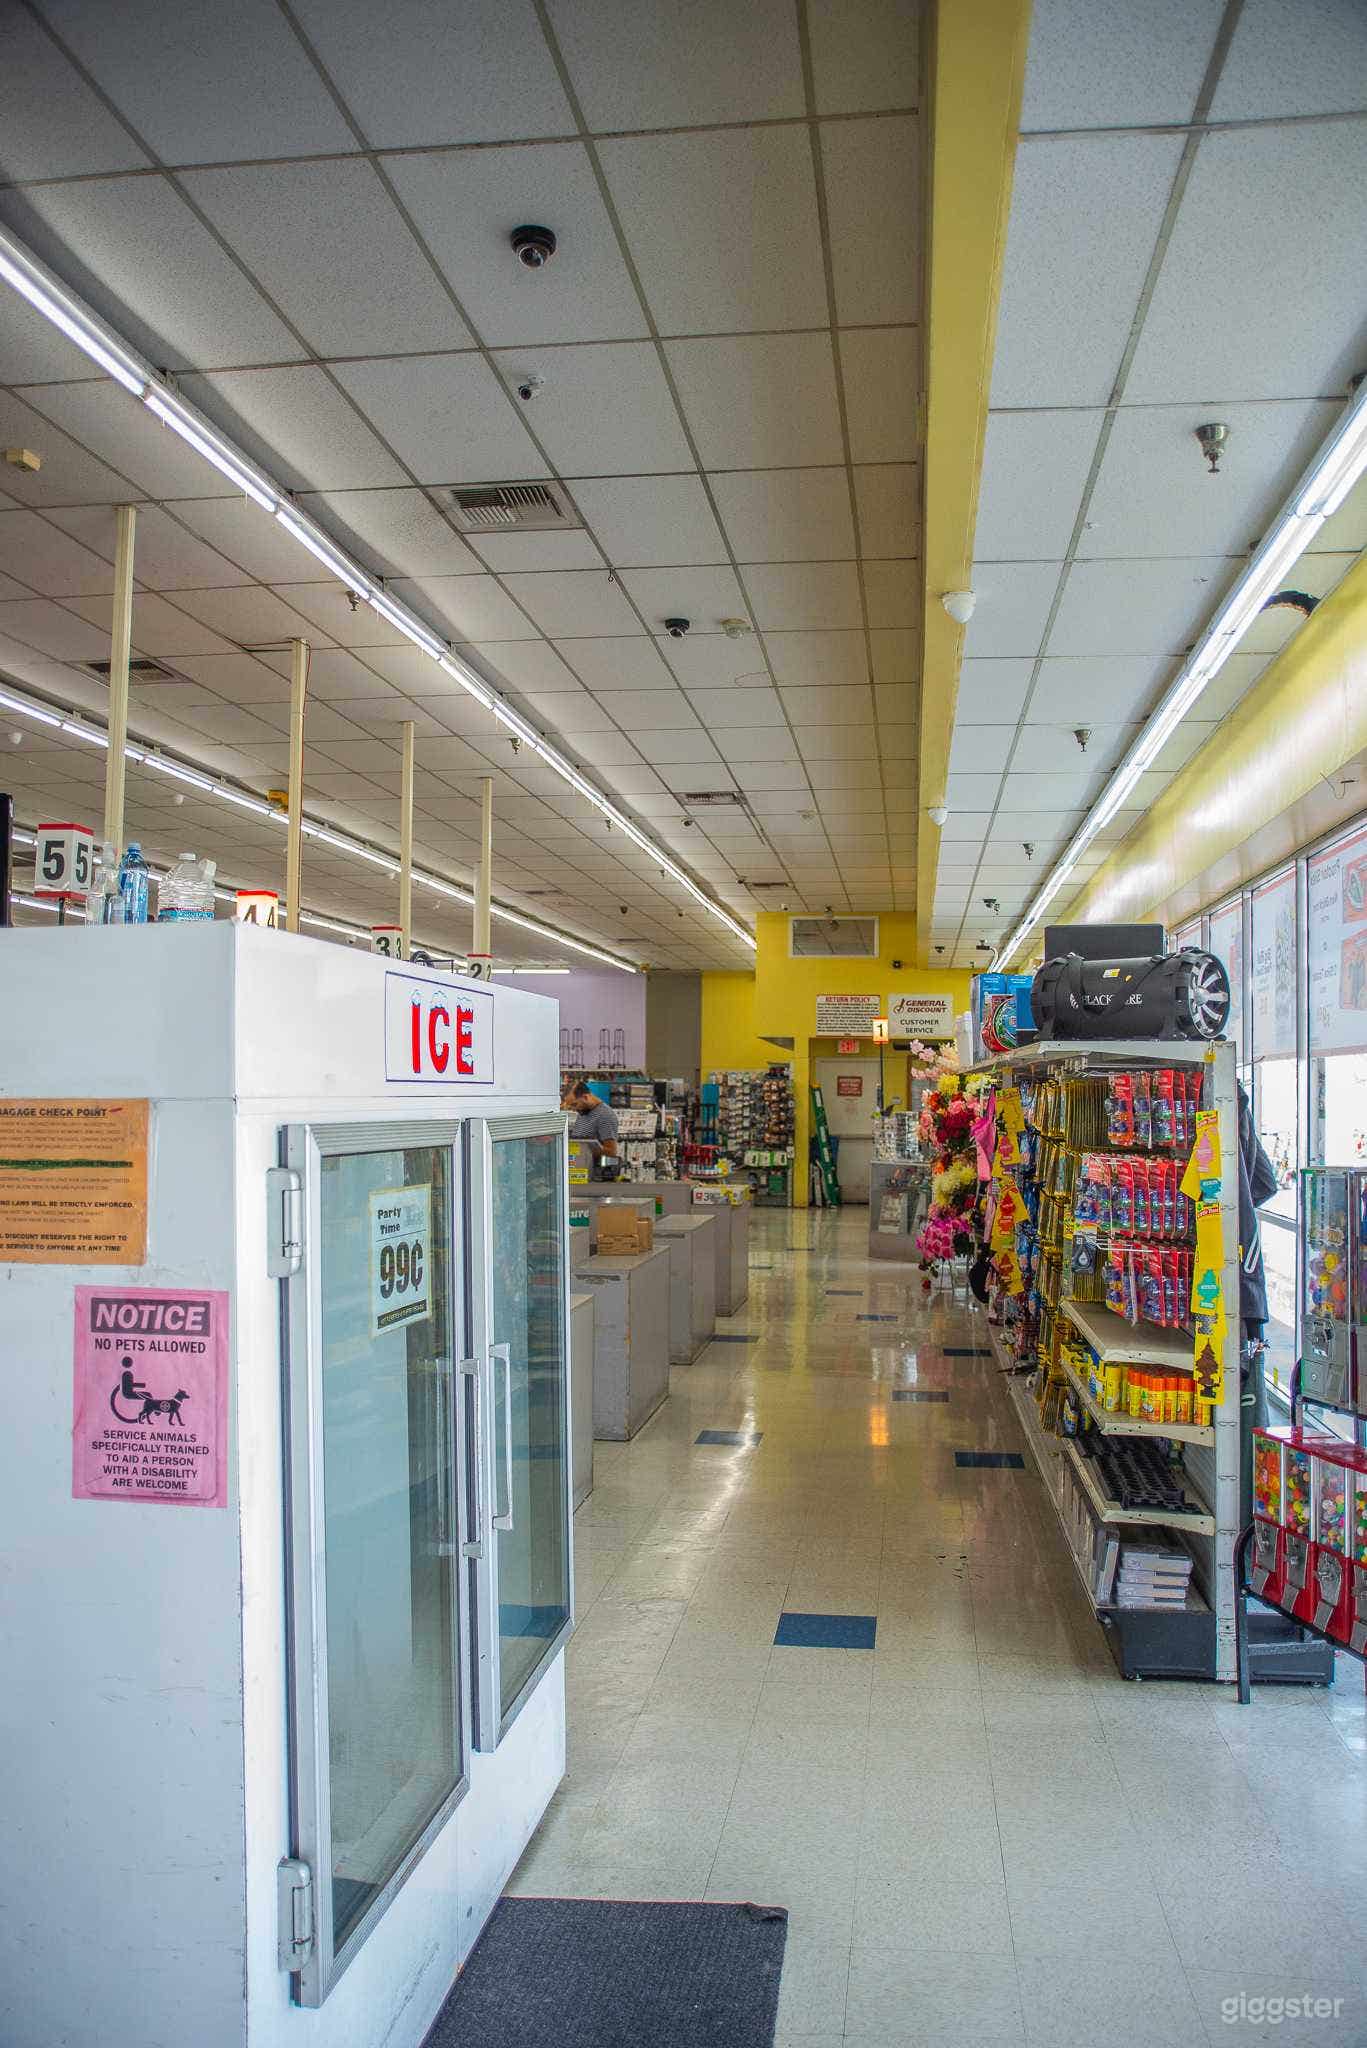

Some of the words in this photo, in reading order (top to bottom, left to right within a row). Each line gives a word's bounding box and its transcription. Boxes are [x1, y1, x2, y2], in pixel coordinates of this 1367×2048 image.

[43, 841, 65, 881] 5
[76, 842, 89, 884] 5
[376, 937, 391, 957] 3
[410, 989, 475, 1075] ICE
[876, 1024, 883, 1037] 1
[39, 1108, 74, 1117] CHECK
[76, 1108, 107, 1117] POINT
[377, 1207, 401, 1220] Party
[380, 1223, 400, 1235] Time
[380, 1239, 423, 1299] 99¢
[95, 1303, 206, 1332] NOTICE
[94, 1338, 111, 1350] NO
[115, 1339, 145, 1351] PETS
[149, 1342, 206, 1354] ALLOWED
[103, 1430, 147, 1441] SERVICE
[149, 1432, 197, 1443] ANIMALS
[91, 1441, 161, 1453] SPECIFICALLY
[164, 1444, 209, 1455] TRAINED
[106, 1453, 118, 1462] TO
[121, 1454, 139, 1464] AID
[142, 1456, 149, 1464] A
[151, 1456, 194, 1466] PERSON
[102, 1465, 129, 1475] WITH
[132, 1466, 139, 1476] A
[141, 1467, 197, 1479] DISABILITY
[112, 1478, 132, 1487] ARE
[135, 1479, 188, 1490] WELCOME
